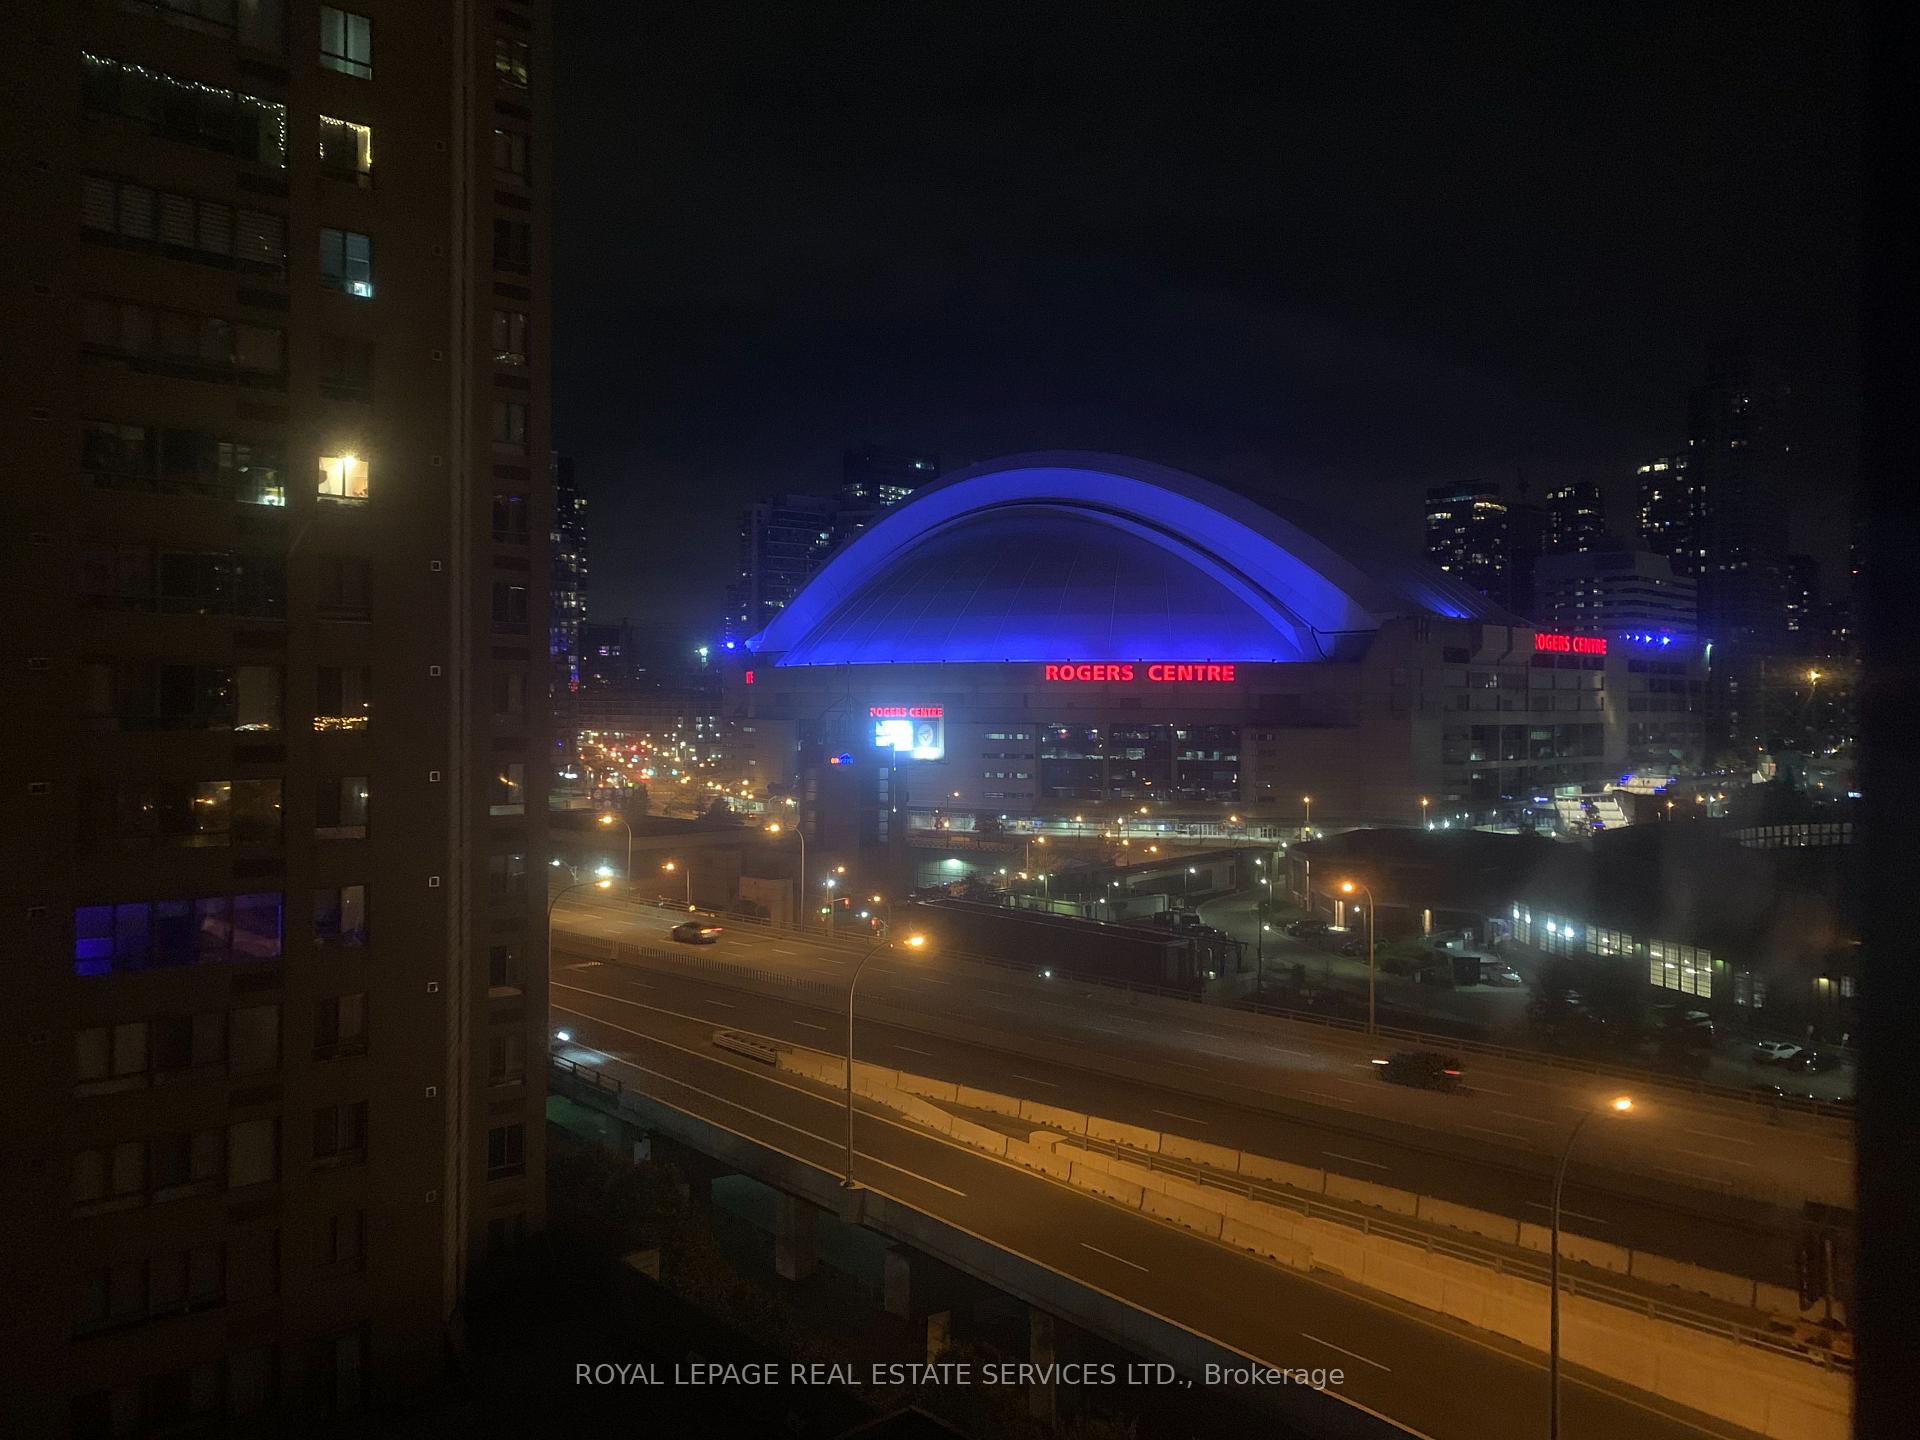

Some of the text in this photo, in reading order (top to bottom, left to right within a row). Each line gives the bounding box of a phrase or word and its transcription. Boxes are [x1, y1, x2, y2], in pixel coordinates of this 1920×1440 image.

[1573, 636, 1607, 654] CENTRE
[1045, 664, 1235, 681] ROGERS CENTRE
[909, 707, 943, 718] CENTRE
